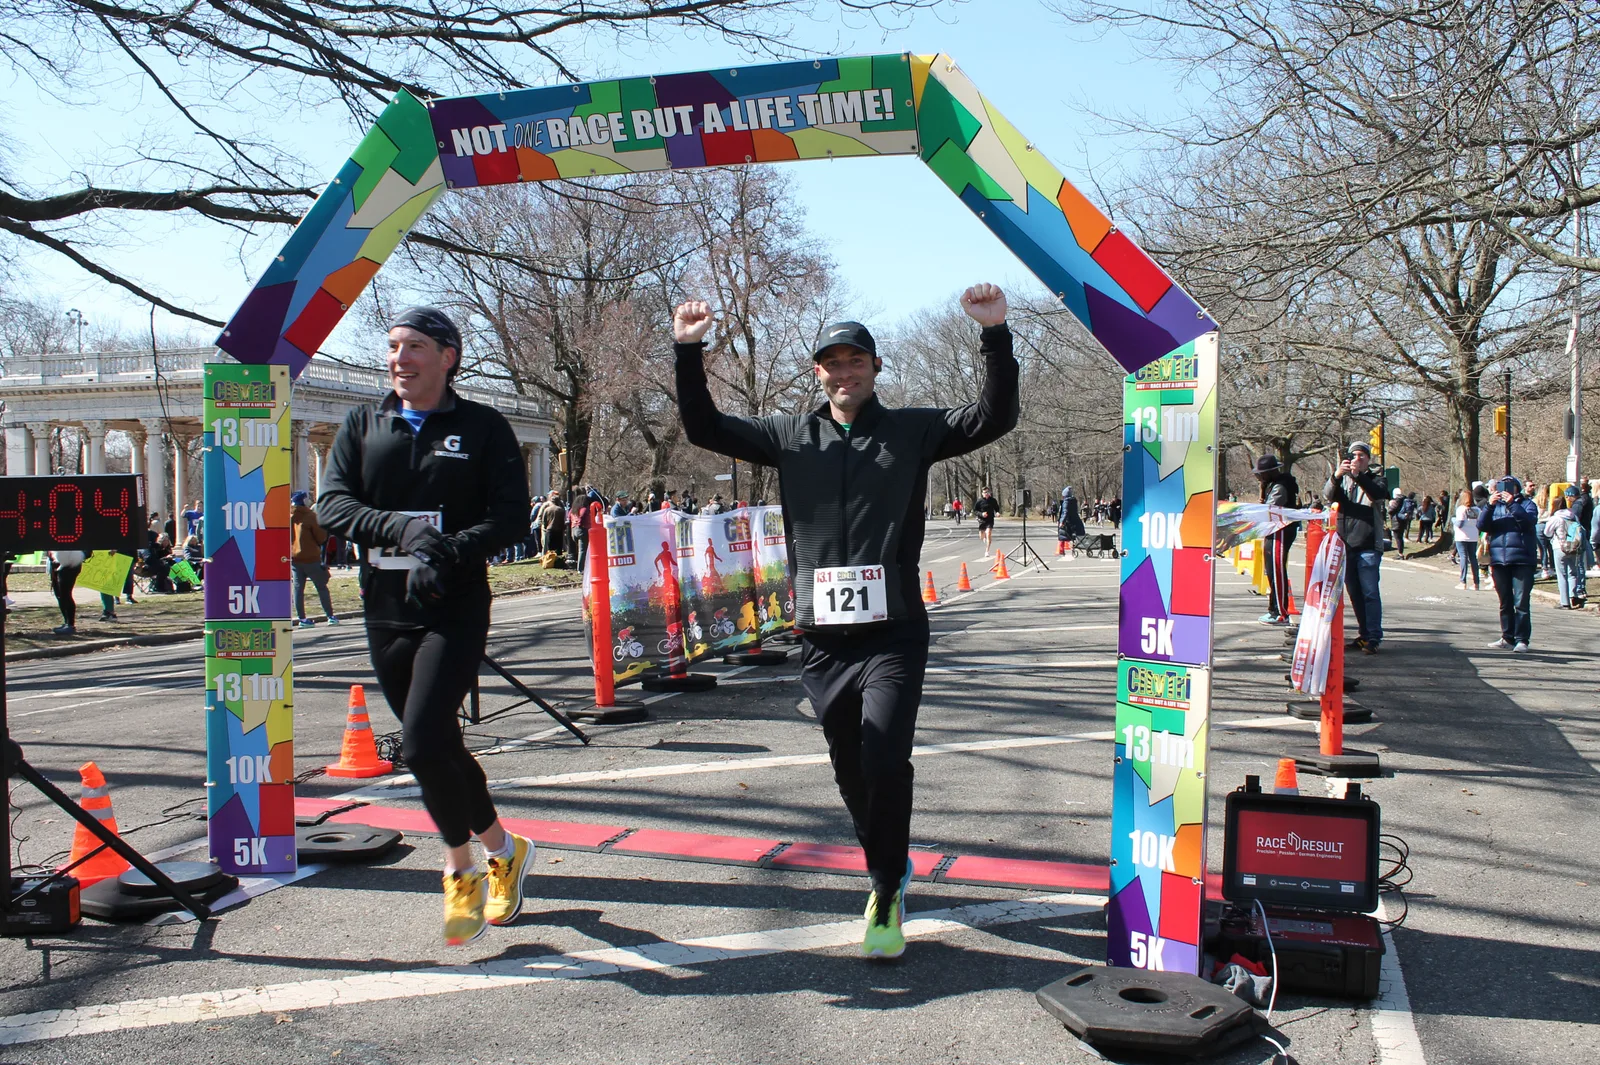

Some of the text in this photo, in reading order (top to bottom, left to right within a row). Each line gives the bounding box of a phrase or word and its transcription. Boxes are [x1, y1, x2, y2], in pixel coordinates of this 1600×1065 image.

[451, 88, 896, 157] NOT ONE RACE BUT A LIFE TIME!
[211, 418, 279, 447] 13.1m
[1131, 406, 1199, 442] 13.1m
[444, 435, 461, 452] G
[221, 502, 266, 530] 10K
[1138, 512, 1183, 549] 10K
[618, 557, 633, 565] DID
[817, 571, 832, 582] 13.1
[861, 567, 882, 580] 13.1
[228, 586, 260, 614] 5K
[826, 586, 869, 612] 121
[1140, 617, 1174, 656] 5K
[213, 673, 284, 702] 13.1m
[1127, 666, 1191, 699] CityTri
[1122, 724, 1194, 769] 13.1m
[225, 755, 272, 784] 10K
[234, 838, 268, 866] 5K
[1128, 829, 1176, 872] 10K
[1256, 836, 1344, 853] RACE RESULT
[1130, 930, 1166, 971] 5K
